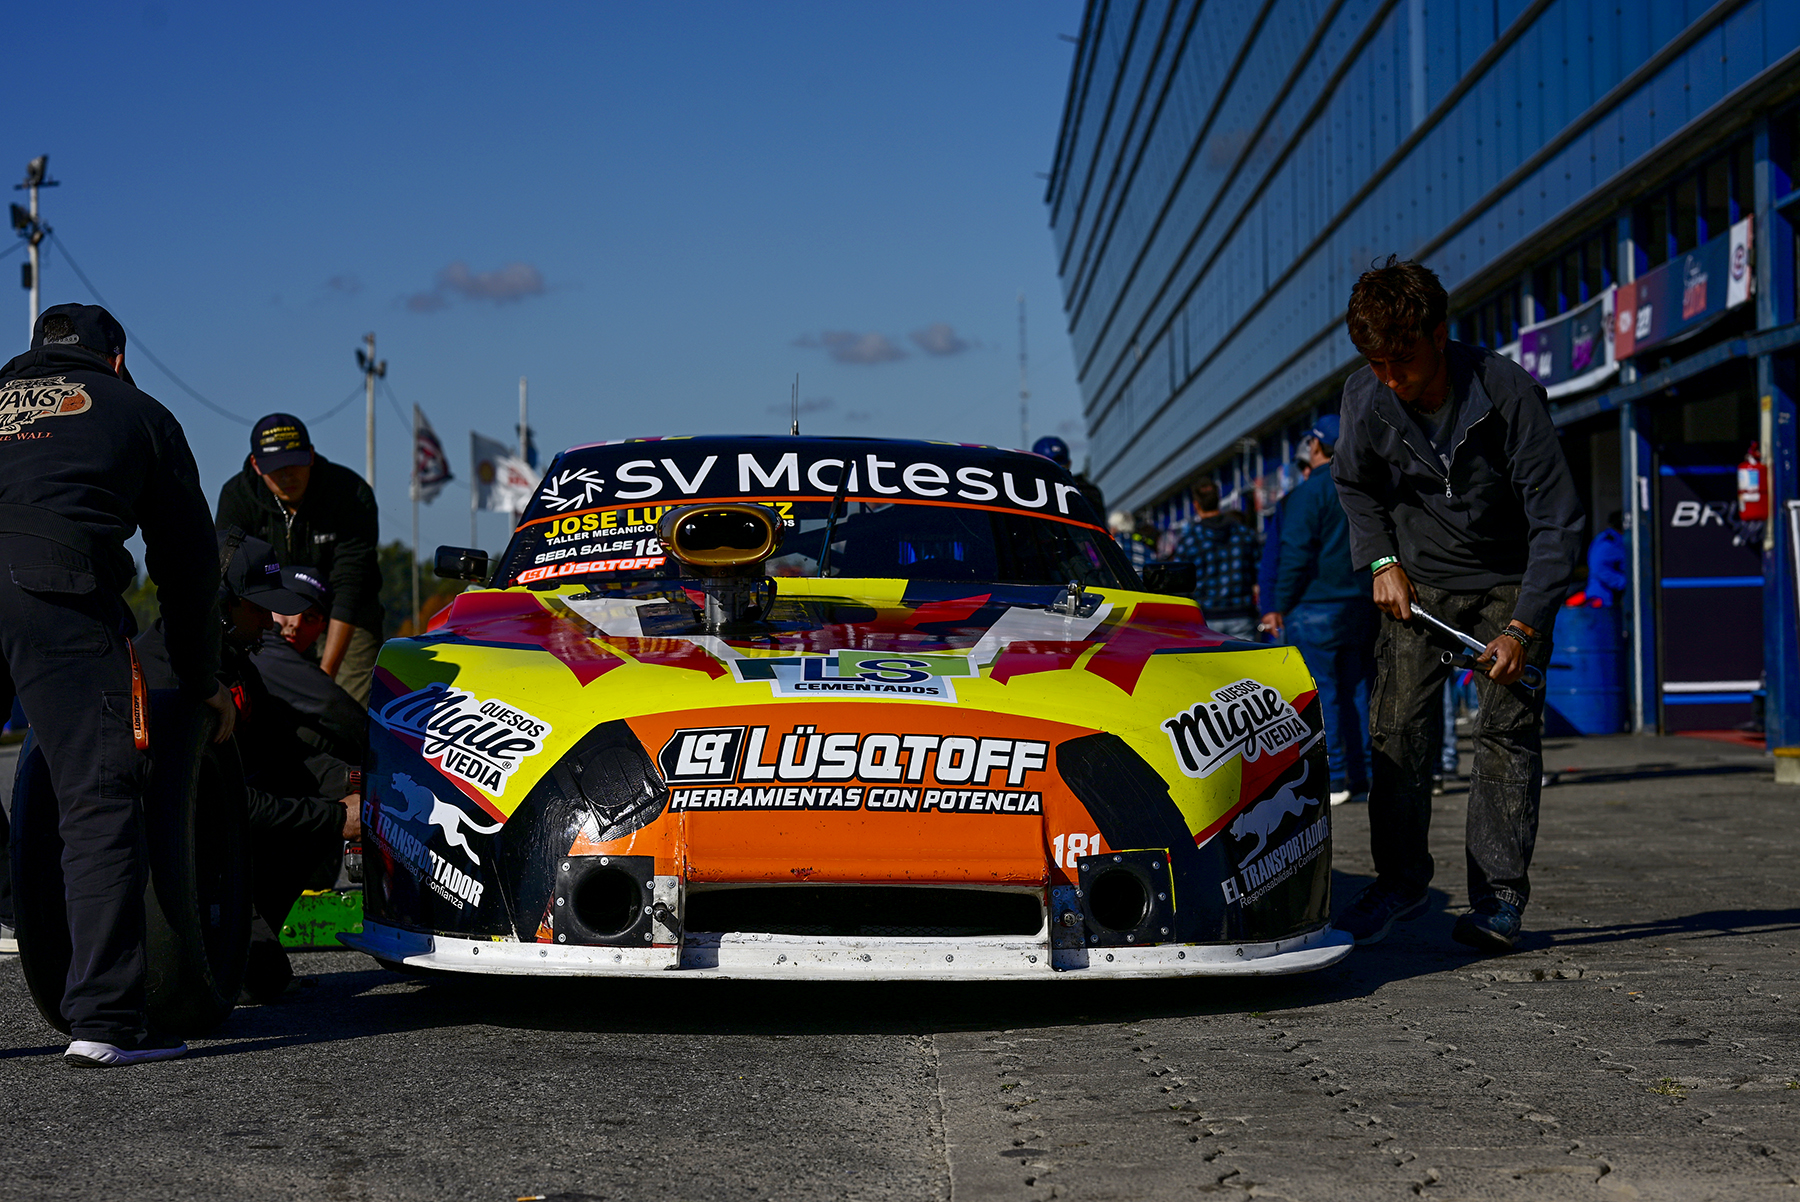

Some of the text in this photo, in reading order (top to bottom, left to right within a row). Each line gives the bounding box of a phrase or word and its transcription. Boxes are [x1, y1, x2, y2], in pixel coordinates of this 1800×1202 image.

[16, 431, 53, 440] WALL
[615, 452, 1082, 514] SV Matesur
[544, 510, 617, 538] JOSE
[546, 524, 654, 546] TALLER MECANICO
[534, 546, 578, 564] SEBA
[580, 540, 633, 556] SALSE
[545, 557, 666, 578] LÜSQTOFF
[801, 657, 930, 684] LS
[794, 682, 939, 695] CEMENTADOS
[1215, 679, 1261, 703] QUESOS
[385, 685, 536, 760] Migue
[479, 702, 545, 737] QUESOS
[1165, 688, 1284, 772] Migue
[1259, 717, 1304, 751] VEDIA
[445, 748, 502, 792] VEDIA
[743, 726, 1046, 784] LÜSQTOFF
[671, 788, 1039, 812] HERRAMIENTAS CON POTENCIA
[362, 800, 484, 908] EL TRANSPORTADOR
[1053, 833, 1100, 868] 181
[1221, 815, 1329, 905] EL TRANSPORTADOR
[367, 829, 418, 876] Responsabilidad
[425, 876, 463, 910] Confianza
[1240, 865, 1293, 908] Responsabilidad
[1298, 844, 1325, 868] Confianza
